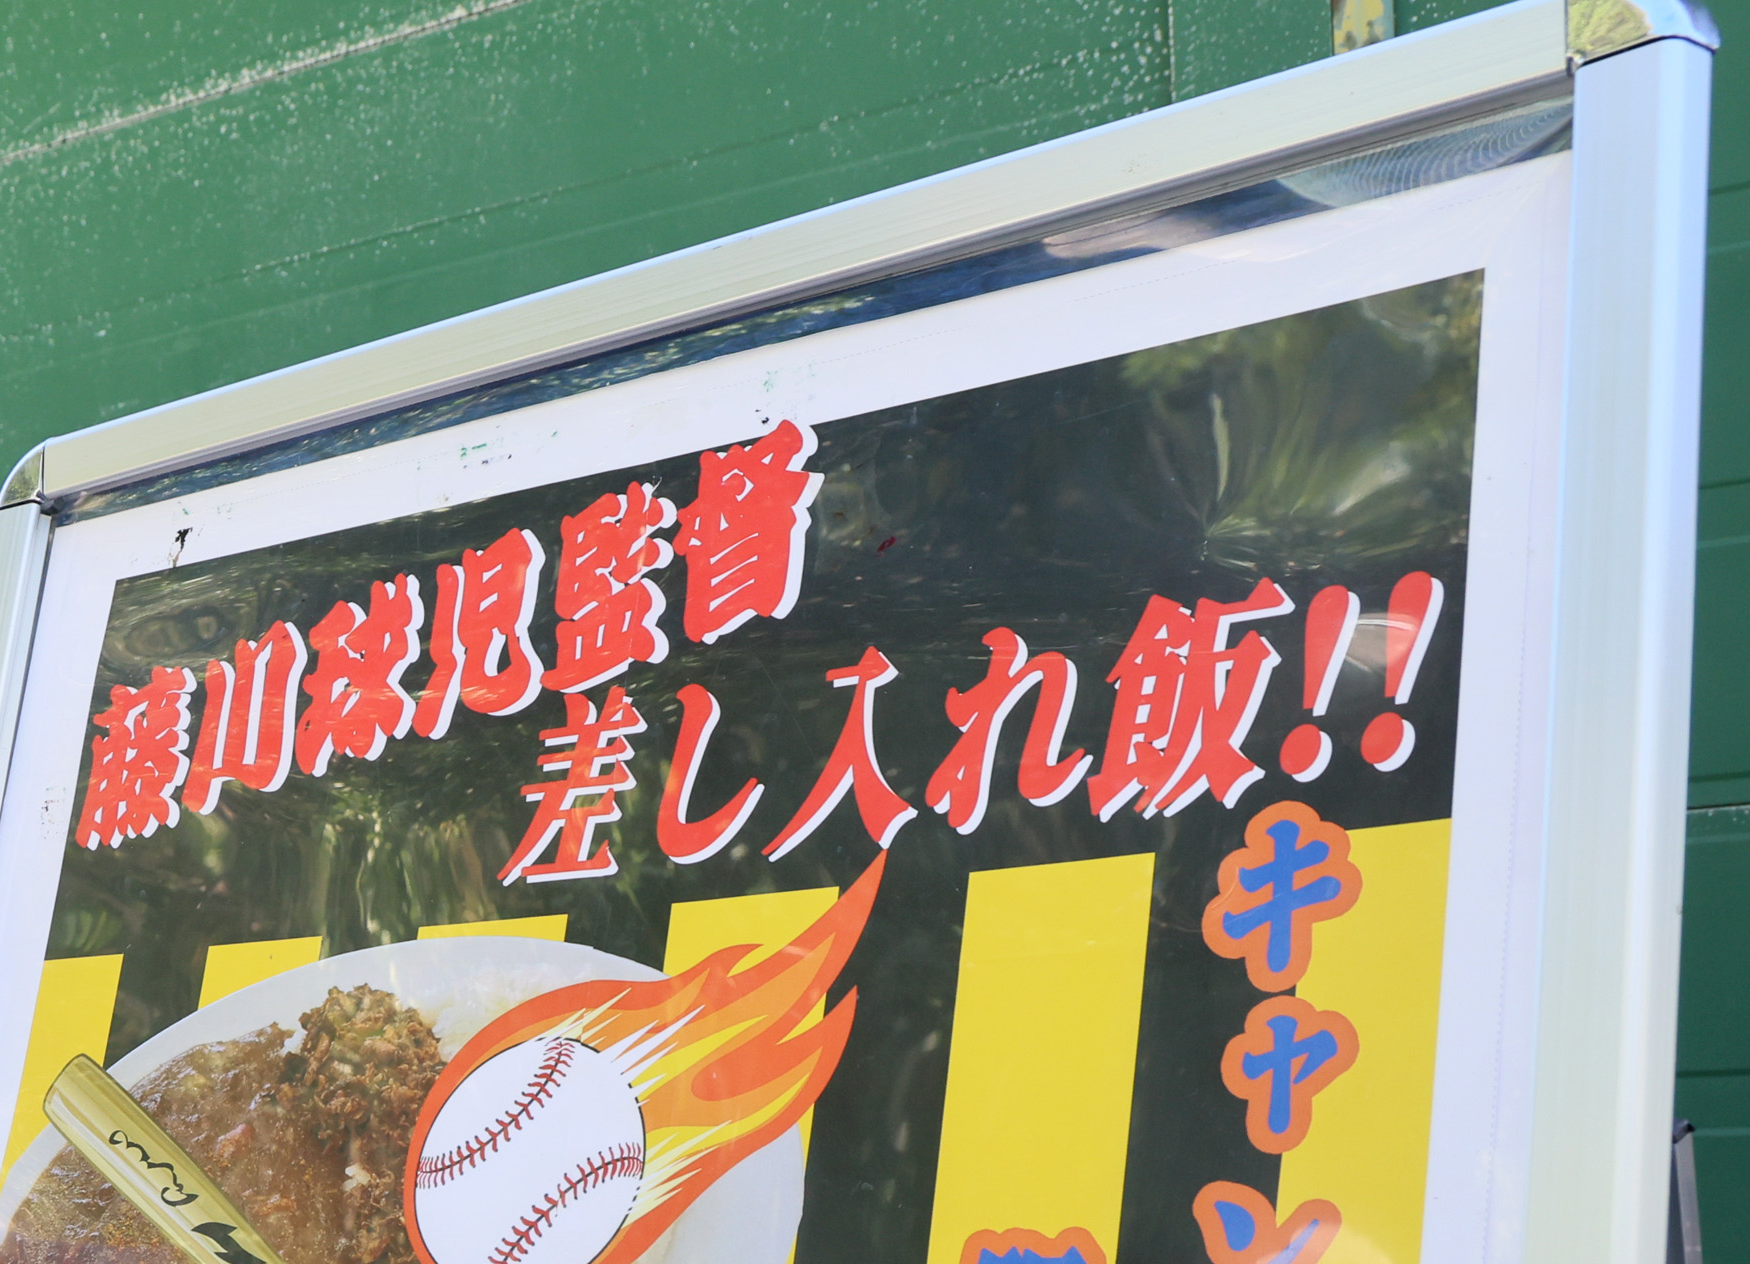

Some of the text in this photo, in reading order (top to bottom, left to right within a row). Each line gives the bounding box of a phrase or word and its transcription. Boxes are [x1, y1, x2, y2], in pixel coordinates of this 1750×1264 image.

[75, 418, 826, 850] 藤川球児監督
